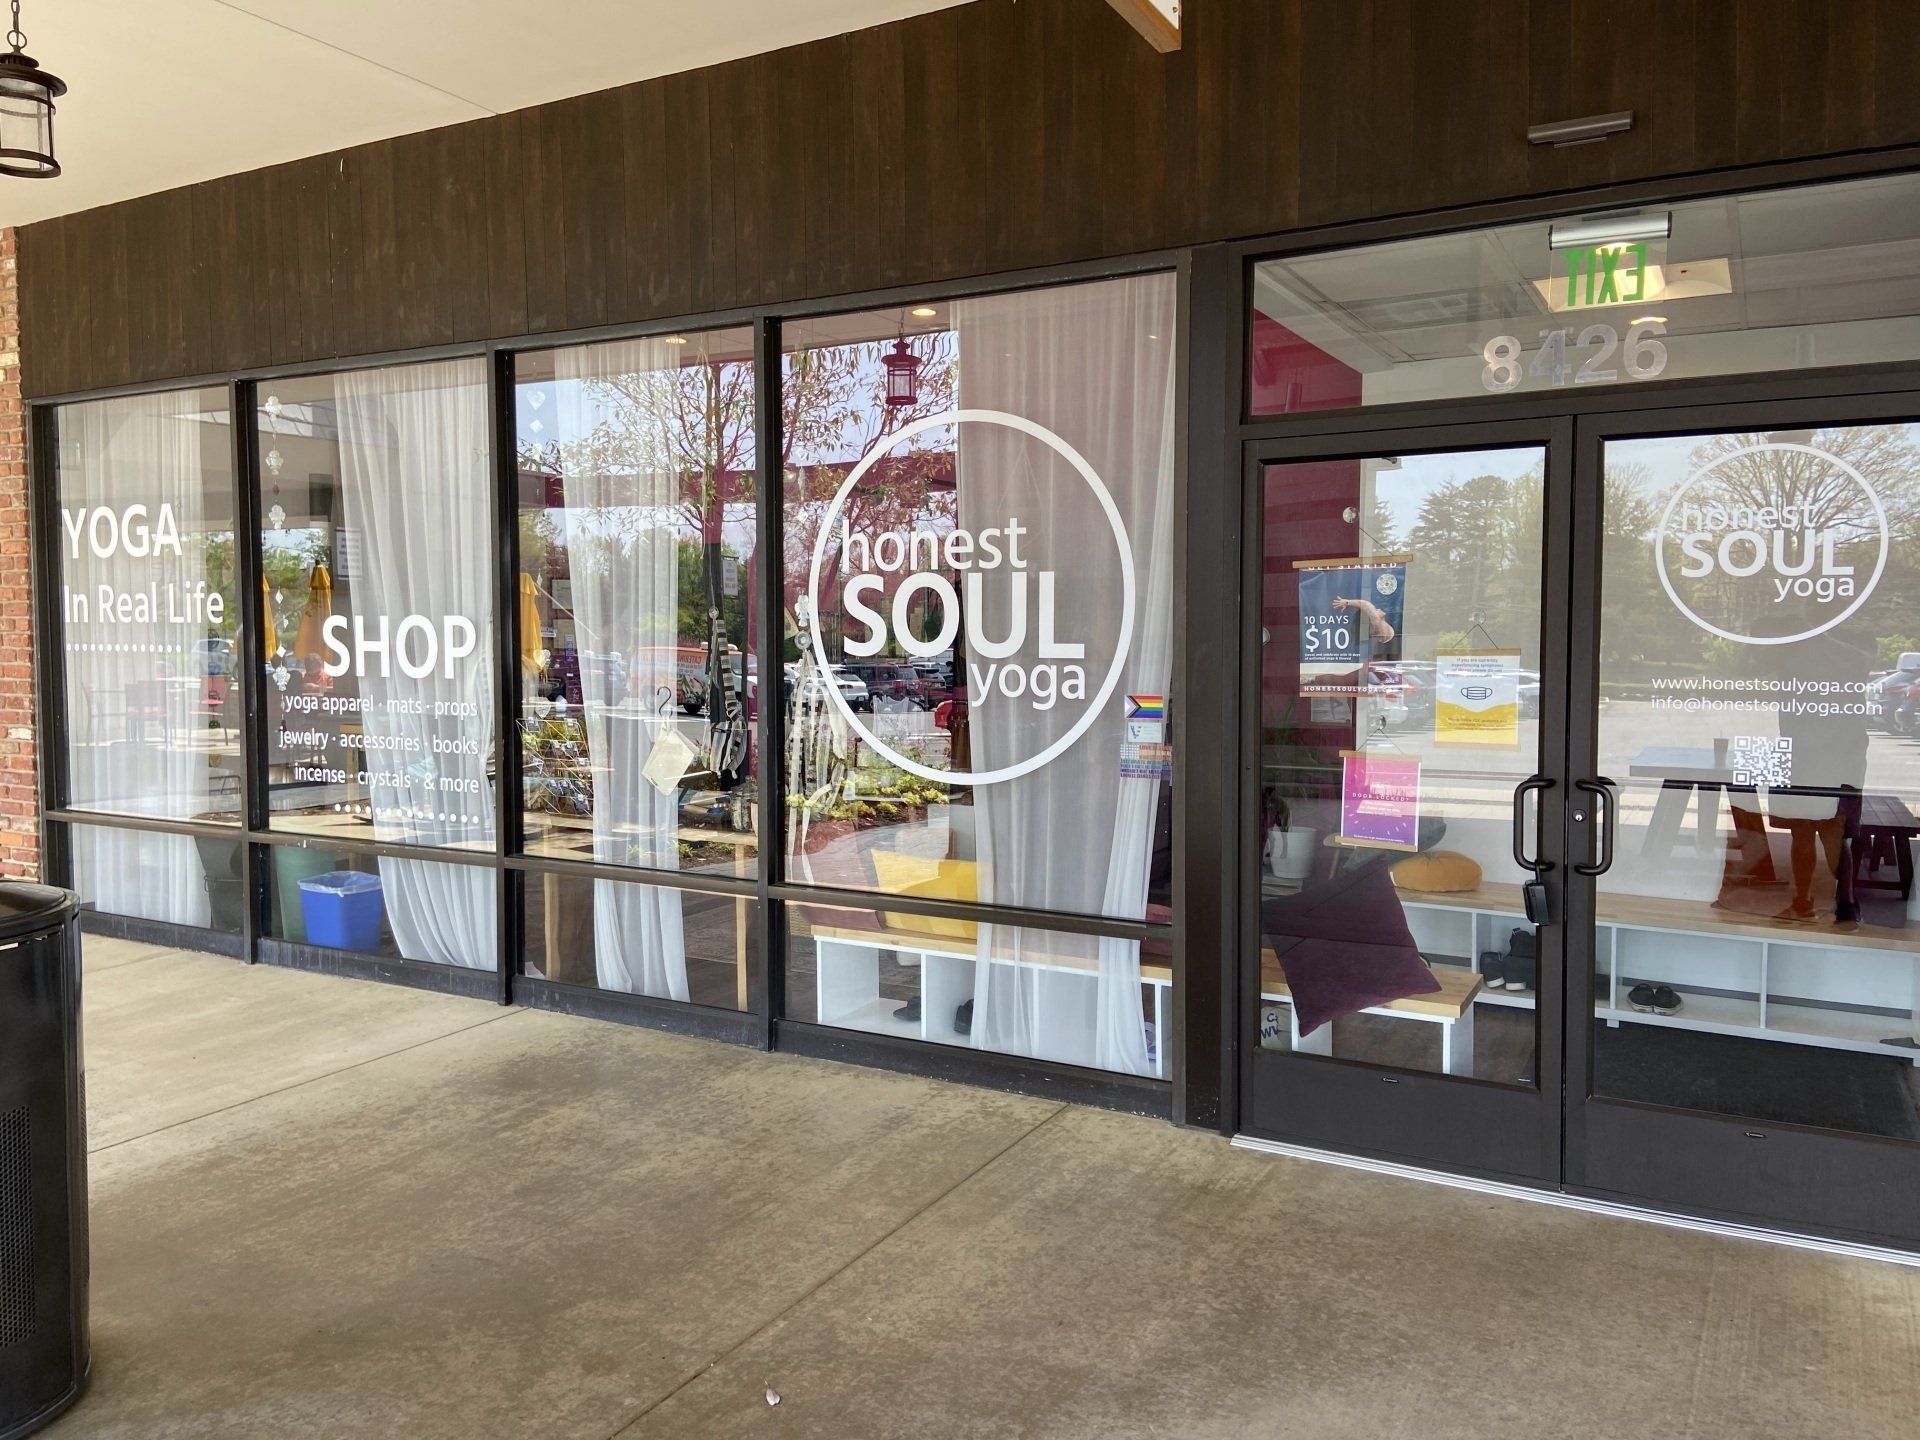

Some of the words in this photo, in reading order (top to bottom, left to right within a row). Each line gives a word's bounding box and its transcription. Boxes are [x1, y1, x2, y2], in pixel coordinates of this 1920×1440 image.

[1481, 319, 1668, 393] 8426
[62, 503, 183, 559] YOGA
[1681, 501, 1816, 531] honest
[842, 517, 1027, 571] honest
[1681, 528, 1855, 578] SOUL
[64, 585, 89, 624] In
[98, 581, 158, 624] Real
[169, 580, 225, 624] Life
[1774, 576, 1855, 603] yoga
[843, 571, 1085, 660] SOUL
[1304, 615, 1316, 625] 10
[1319, 615, 1349, 625] DAYS
[322, 614, 477, 680] SHOP
[1305, 625, 1350, 653] $10
[970, 662, 1086, 711] yoga
[1651, 676, 1884, 695] www.honestsoulyoga.com
[285, 694, 319, 713] yoga
[322, 695, 374, 715] apparel
[387, 698, 422, 714] mats
[435, 701, 478, 720] props
[1651, 695, 1883, 716] info@honestsoulyoga.com
[279, 727, 329, 750] jewelry
[339, 732, 420, 751] accessories
[433, 734, 479, 755] books
[294, 762, 346, 784] incense
[357, 768, 411, 790] crystals
[423, 772, 436, 790] &
[440, 776, 479, 793] more
